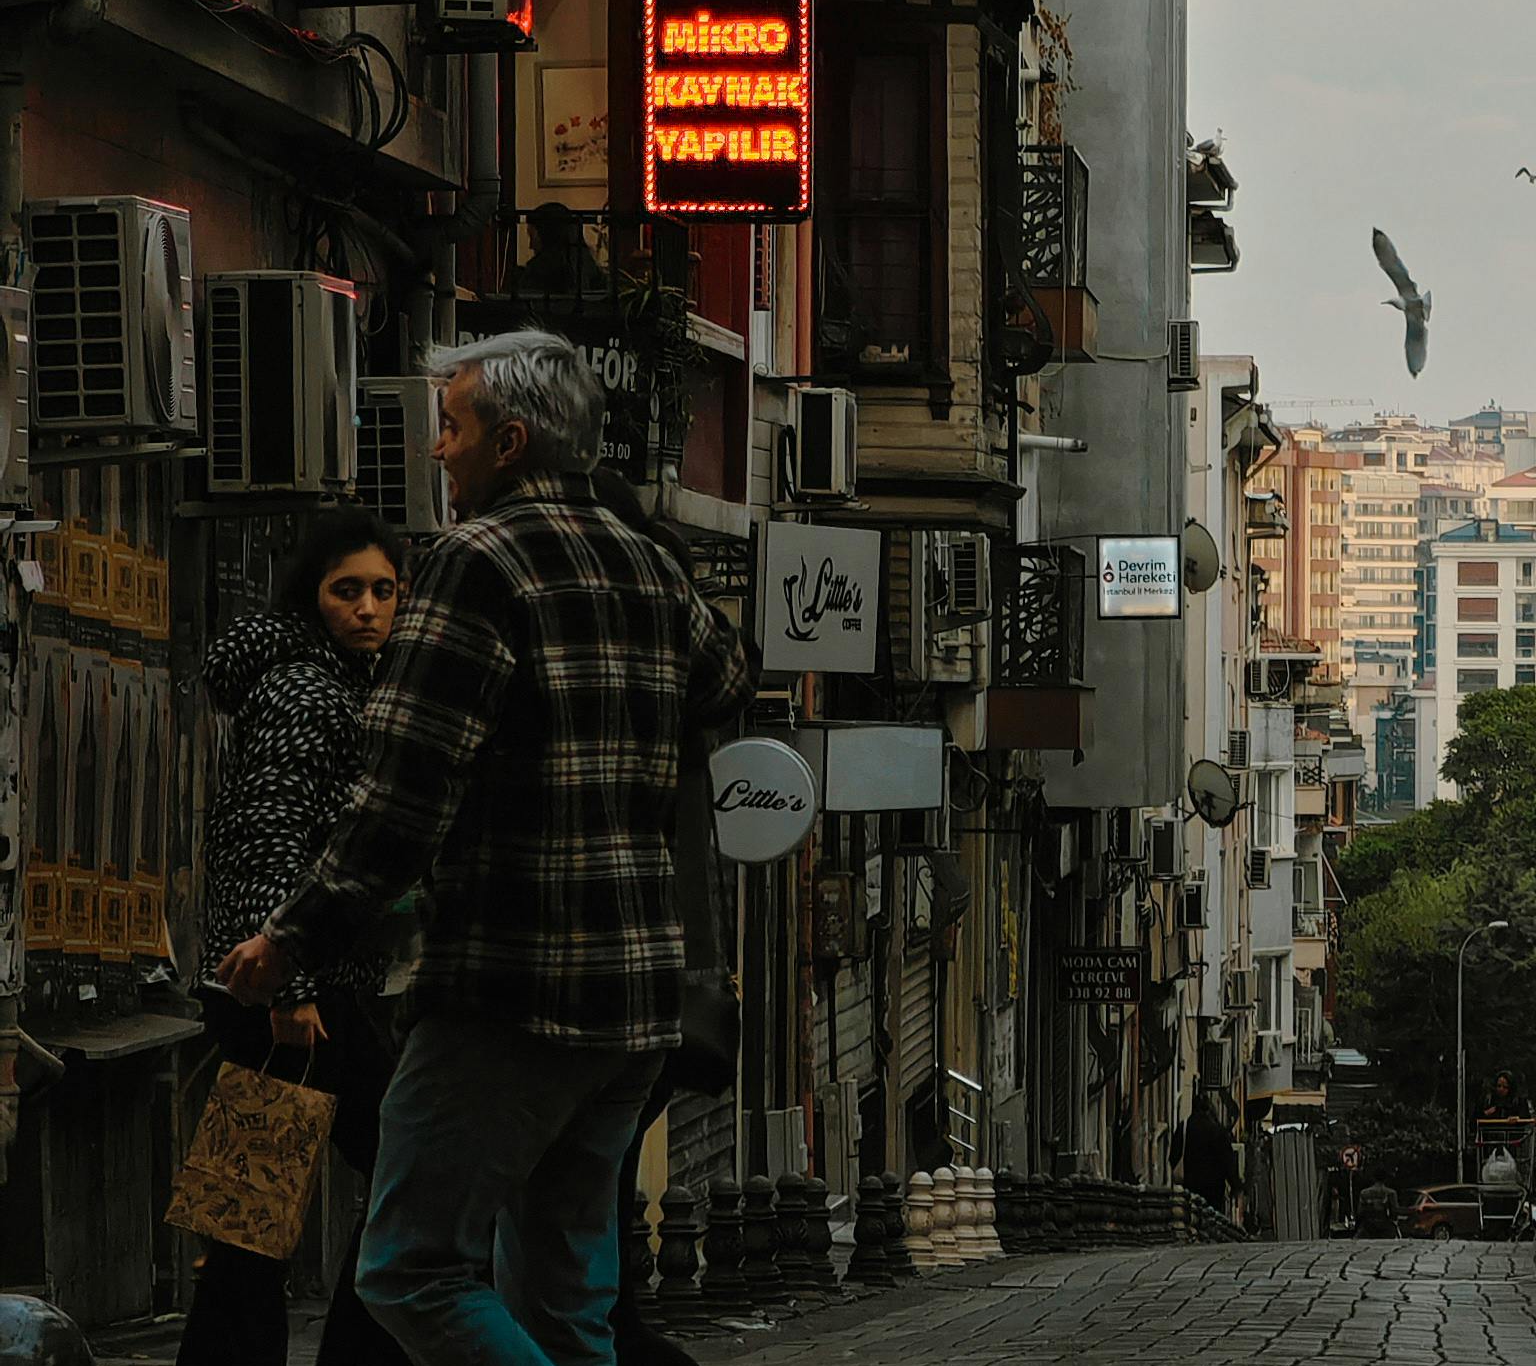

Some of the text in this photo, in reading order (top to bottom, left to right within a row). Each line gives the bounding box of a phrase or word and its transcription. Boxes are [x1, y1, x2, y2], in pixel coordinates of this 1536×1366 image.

[662, 11, 789, 53] MİKRO
[654, 75, 803, 107] KAYNAK
[655, 129, 799, 162] YAPILIR
[1119, 560, 1166, 571] Devrim
[1118, 572, 1177, 584] Hareketi
[1061, 955, 1103, 969] MODA
